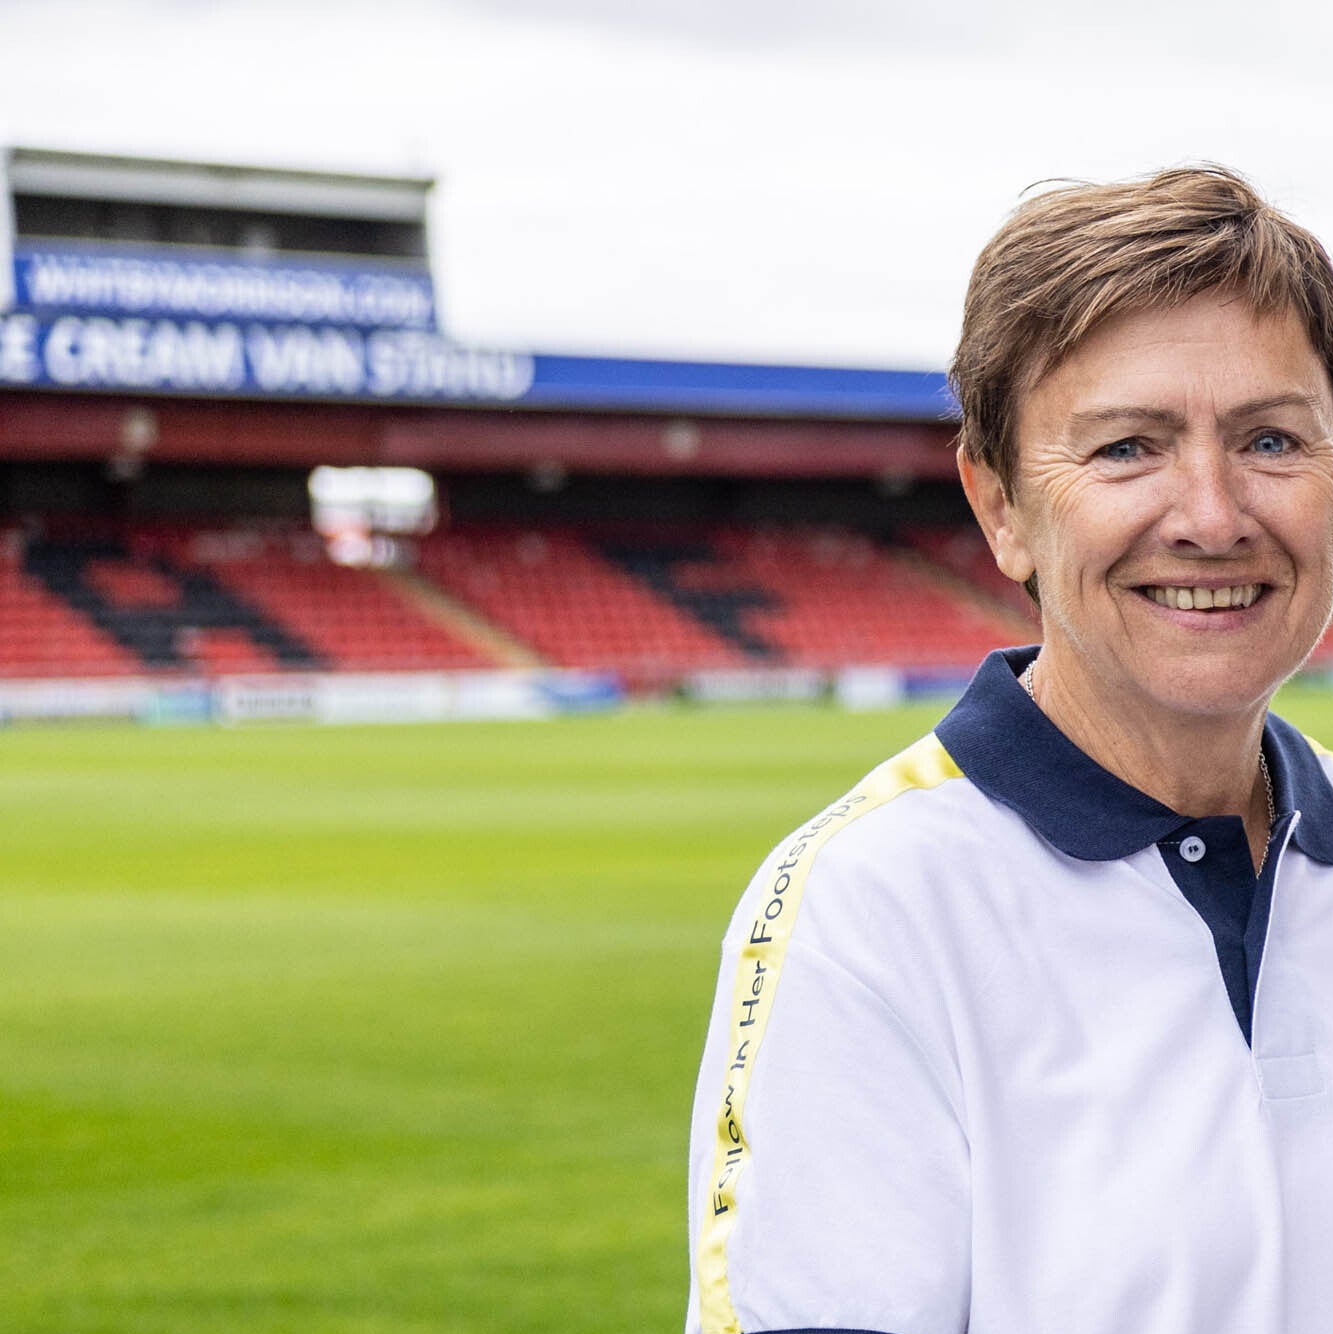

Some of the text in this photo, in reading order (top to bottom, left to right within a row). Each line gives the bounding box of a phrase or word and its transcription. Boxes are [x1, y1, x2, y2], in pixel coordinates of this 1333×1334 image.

[713, 795, 867, 1216] Follow In Her Footsteps
